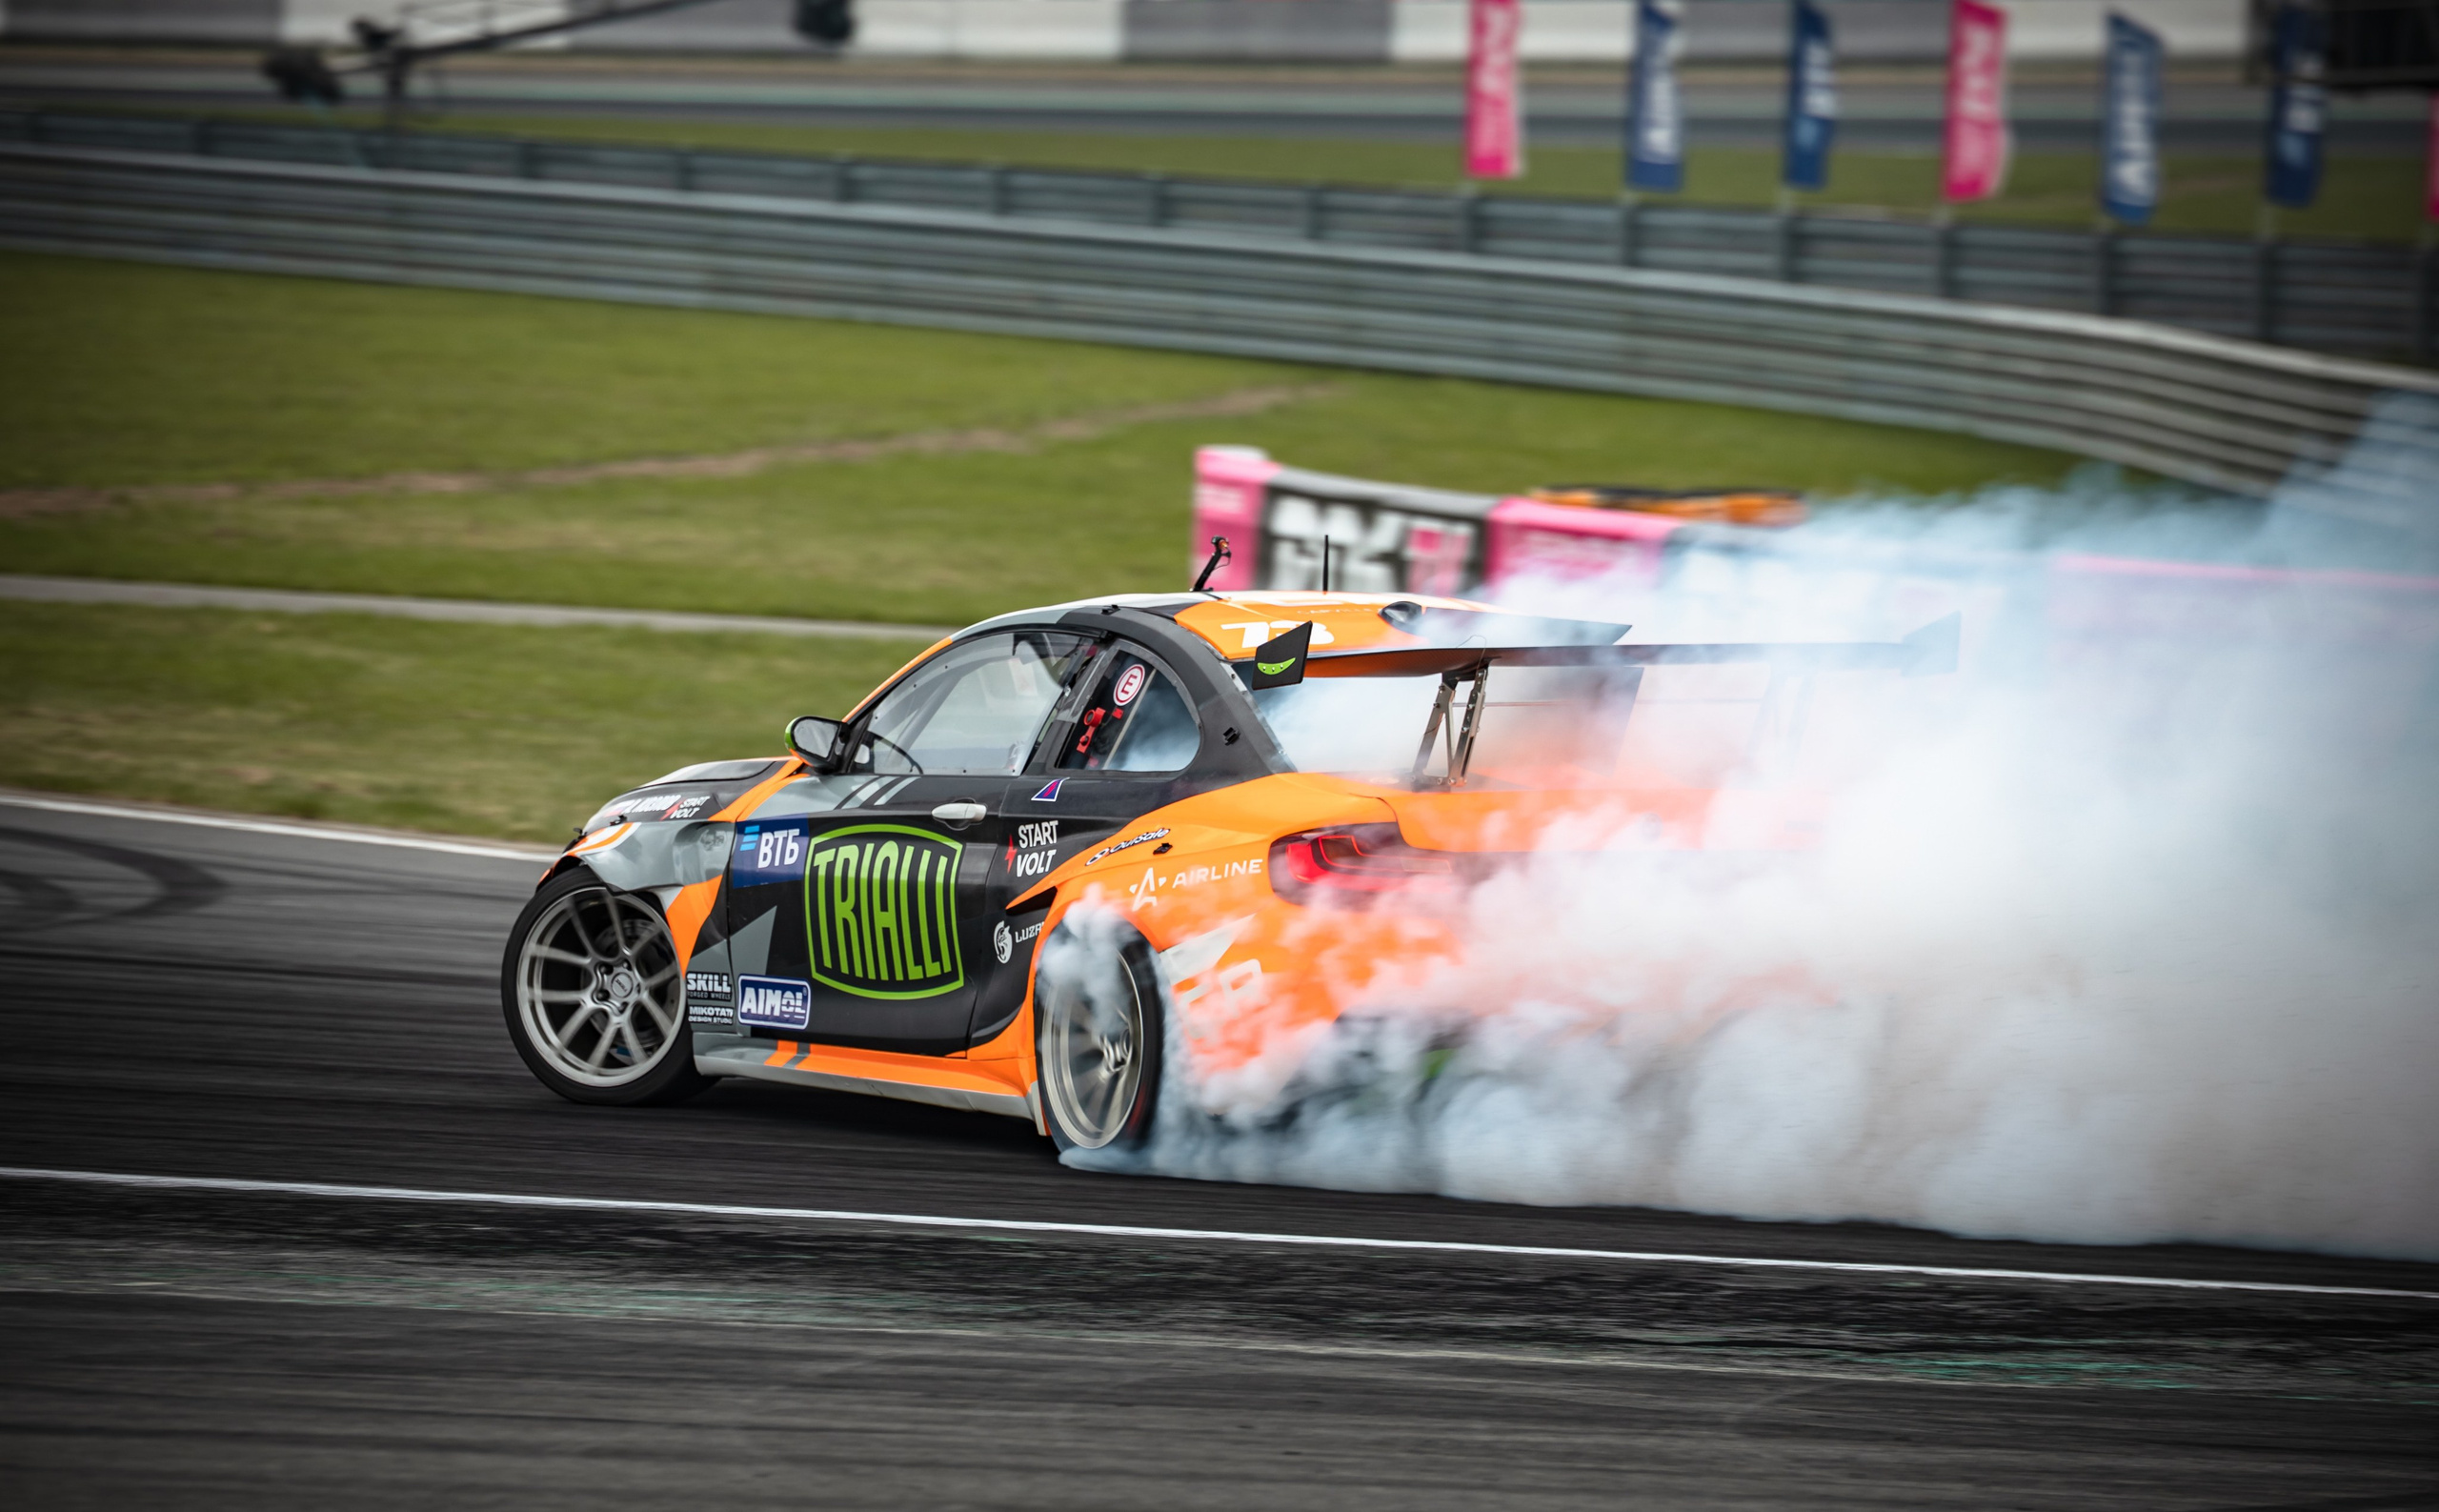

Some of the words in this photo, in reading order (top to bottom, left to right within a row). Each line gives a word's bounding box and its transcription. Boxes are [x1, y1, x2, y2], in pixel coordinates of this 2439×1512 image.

[1120, 674, 1138, 696] E
[670, 807, 700, 819] VOLT
[1018, 820, 1058, 849] START
[1016, 849, 1058, 877] VOLT
[1172, 858, 1263, 889] AIRLINE
[813, 840, 952, 981] TRIALLI
[1015, 922, 1045, 943] LUZA
[686, 973, 732, 993] SKILL
[741, 987, 806, 1018] AIMOL
